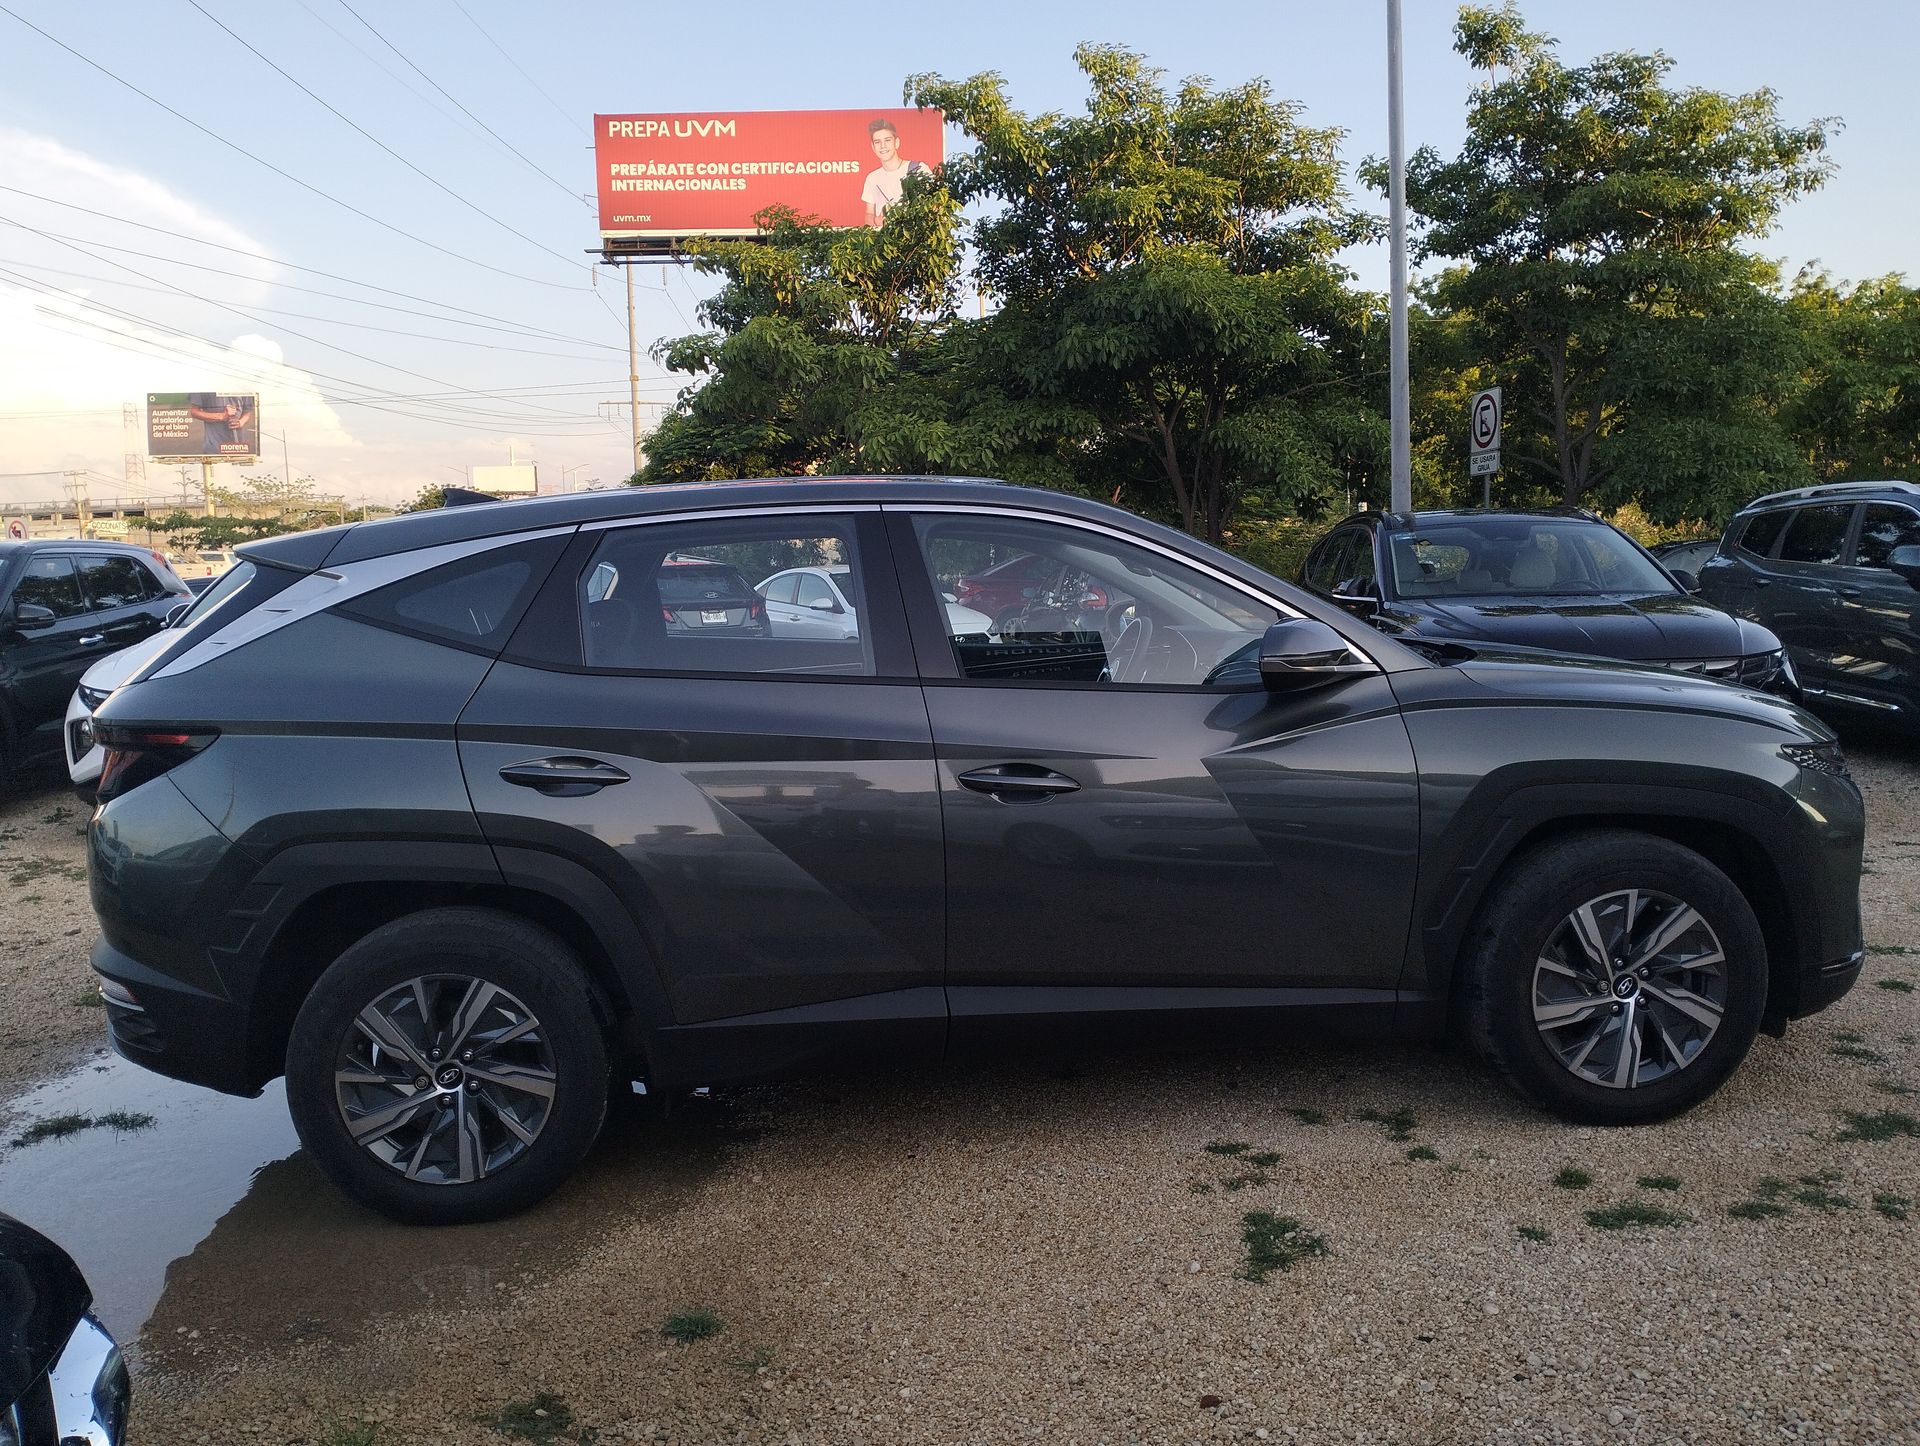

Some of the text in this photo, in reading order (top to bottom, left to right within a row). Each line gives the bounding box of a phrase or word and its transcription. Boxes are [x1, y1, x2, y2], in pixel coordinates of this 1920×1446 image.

[608, 119, 736, 138] PREPA UVM
[610, 160, 860, 176] PREPÁRATE CON CERTIFICACIONES
[611, 178, 747, 192] INTERNACIONALES
[160, 416, 183, 424] salario
[152, 424, 165, 432] por
[163, 430, 189, 438] México
